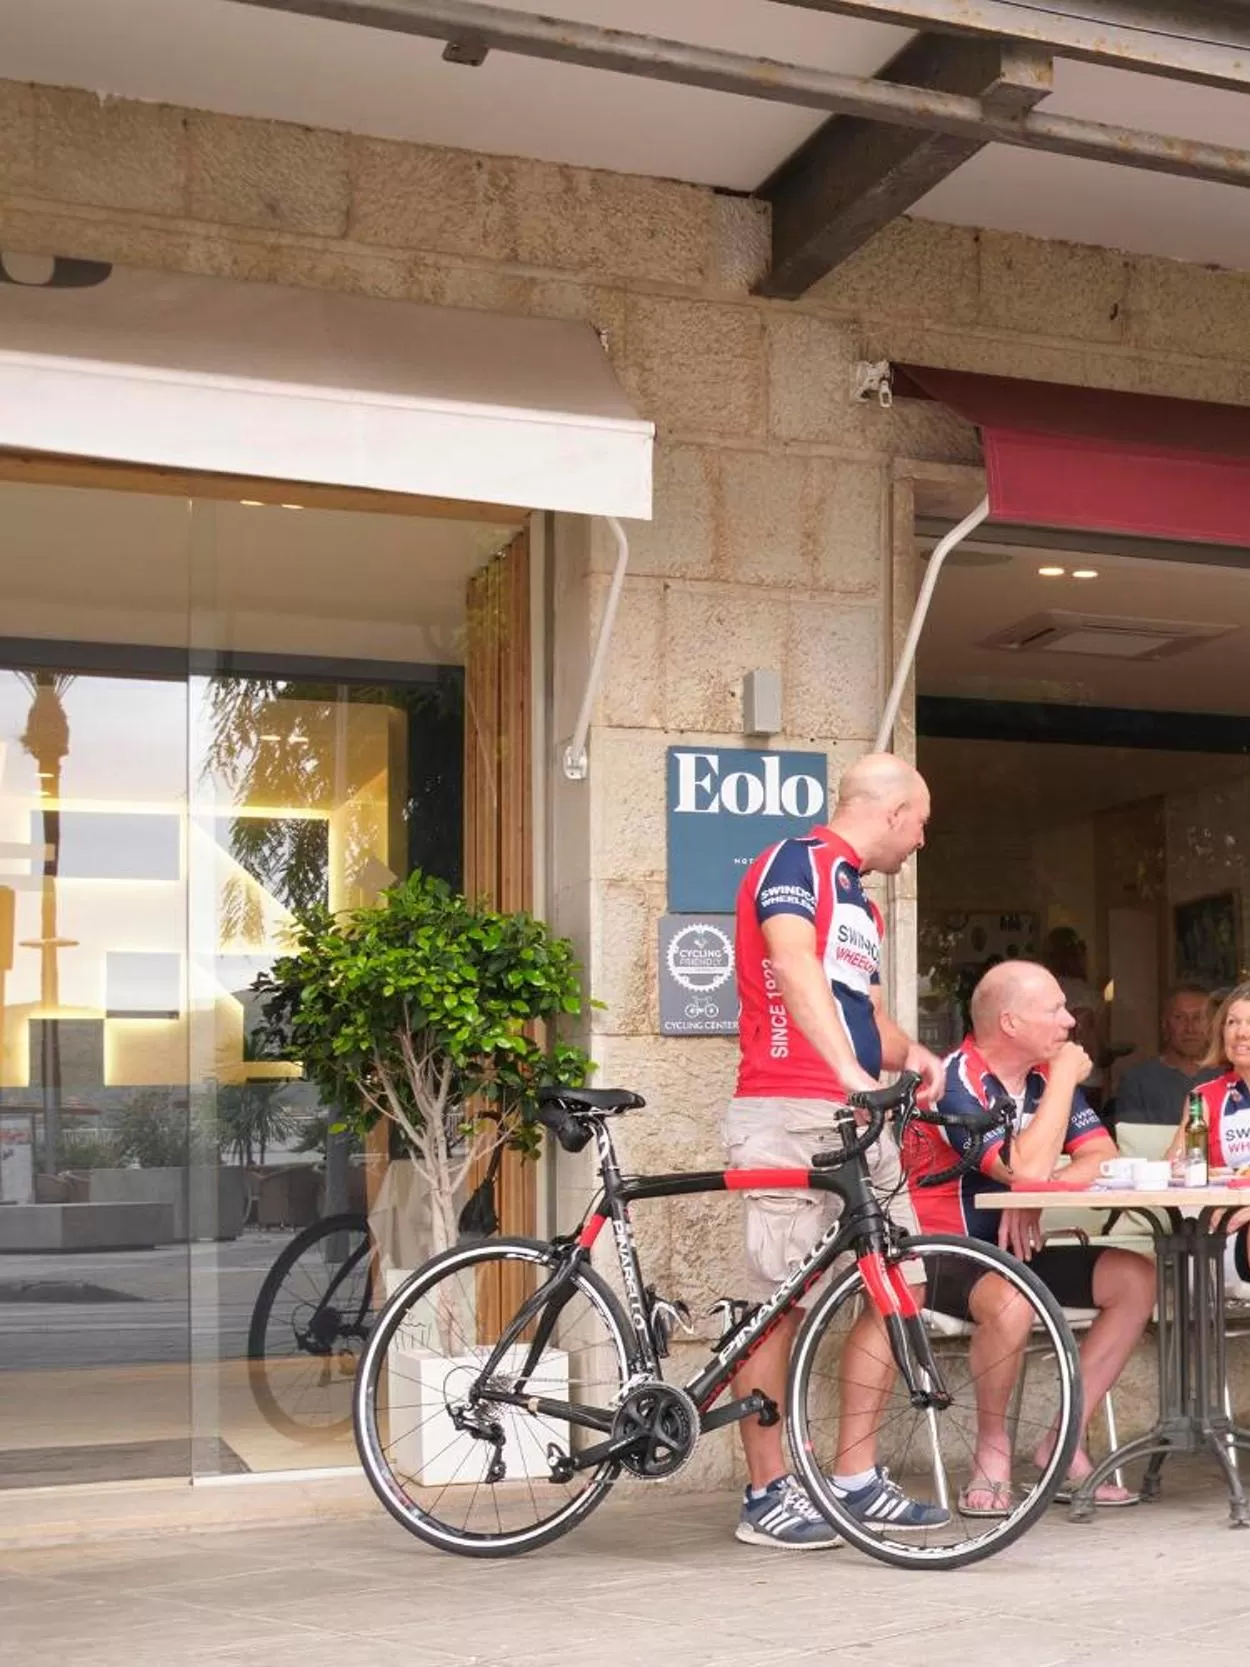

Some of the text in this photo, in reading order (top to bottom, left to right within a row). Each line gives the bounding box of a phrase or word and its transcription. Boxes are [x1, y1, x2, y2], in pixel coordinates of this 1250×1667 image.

[674, 753, 824, 817] Eolo
[734, 857, 755, 865] HOT
[680, 949, 722, 959] CYCLING
[664, 1021, 703, 1031] CYCLING
[769, 1004, 789, 1058] SINCE
[719, 1220, 840, 1366] PINARELLO
